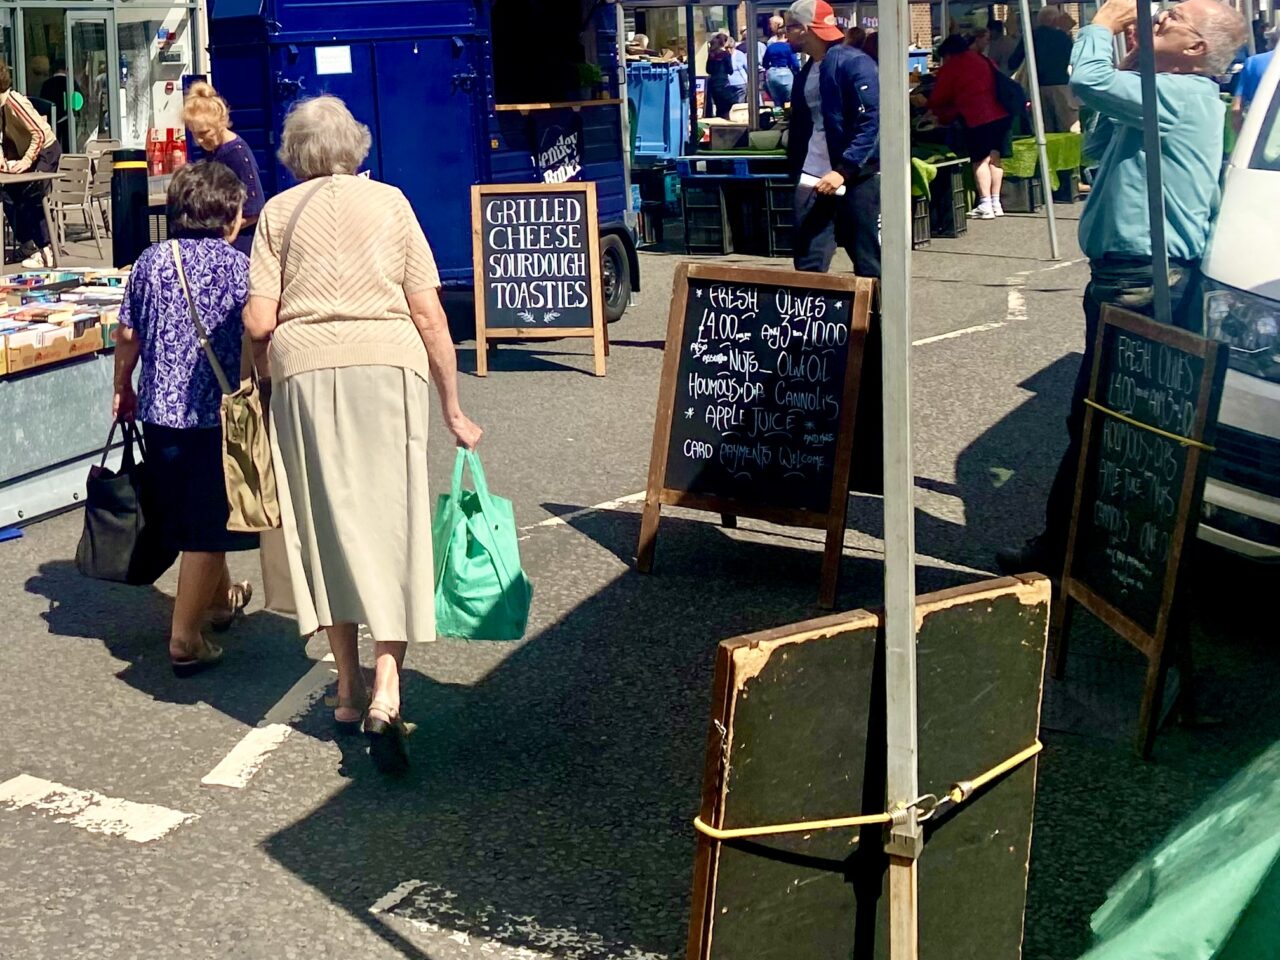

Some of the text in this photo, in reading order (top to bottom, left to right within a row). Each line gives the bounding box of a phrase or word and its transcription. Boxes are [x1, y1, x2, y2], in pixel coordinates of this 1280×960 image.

[486, 198, 581, 225] GRILLED
[489, 224, 582, 250] CHEESE
[489, 252, 586, 278] SOURDOUGH
[490, 280, 589, 309] TOASTIES
[709, 285, 759, 313] FRESH
[729, 346, 759, 381] NUTS
[705, 404, 796, 438] APPLE JUICE
[683, 439, 714, 460] CARD
